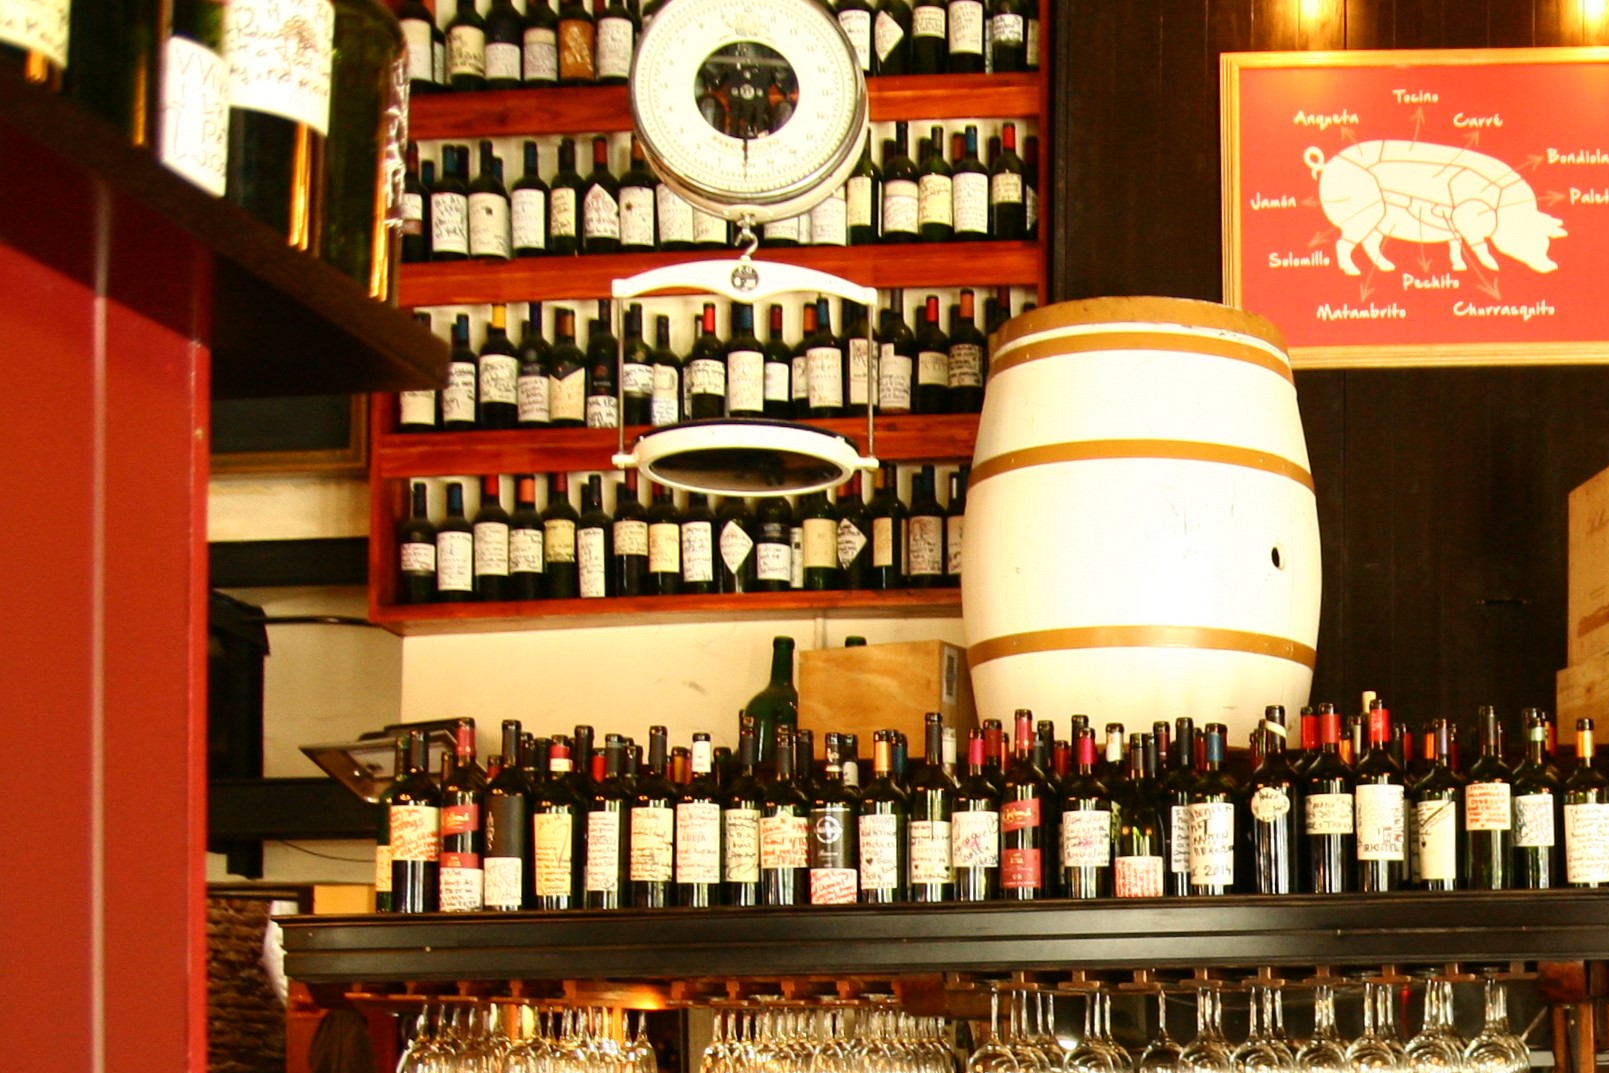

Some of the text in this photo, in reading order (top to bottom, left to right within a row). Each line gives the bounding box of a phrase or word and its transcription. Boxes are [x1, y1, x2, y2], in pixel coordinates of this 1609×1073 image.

[1392, 89, 1439, 104] Tocino
[1453, 113, 1503, 128] Carré
[1547, 148, 1609, 164] Bondiola
[1250, 192, 1296, 210] Jamón
[1268, 251, 1330, 268] Solomillo
[1403, 273, 1460, 290] Pechito
[1317, 303, 1406, 320] Matambrito
[1453, 299, 1556, 322] Churrasquito
